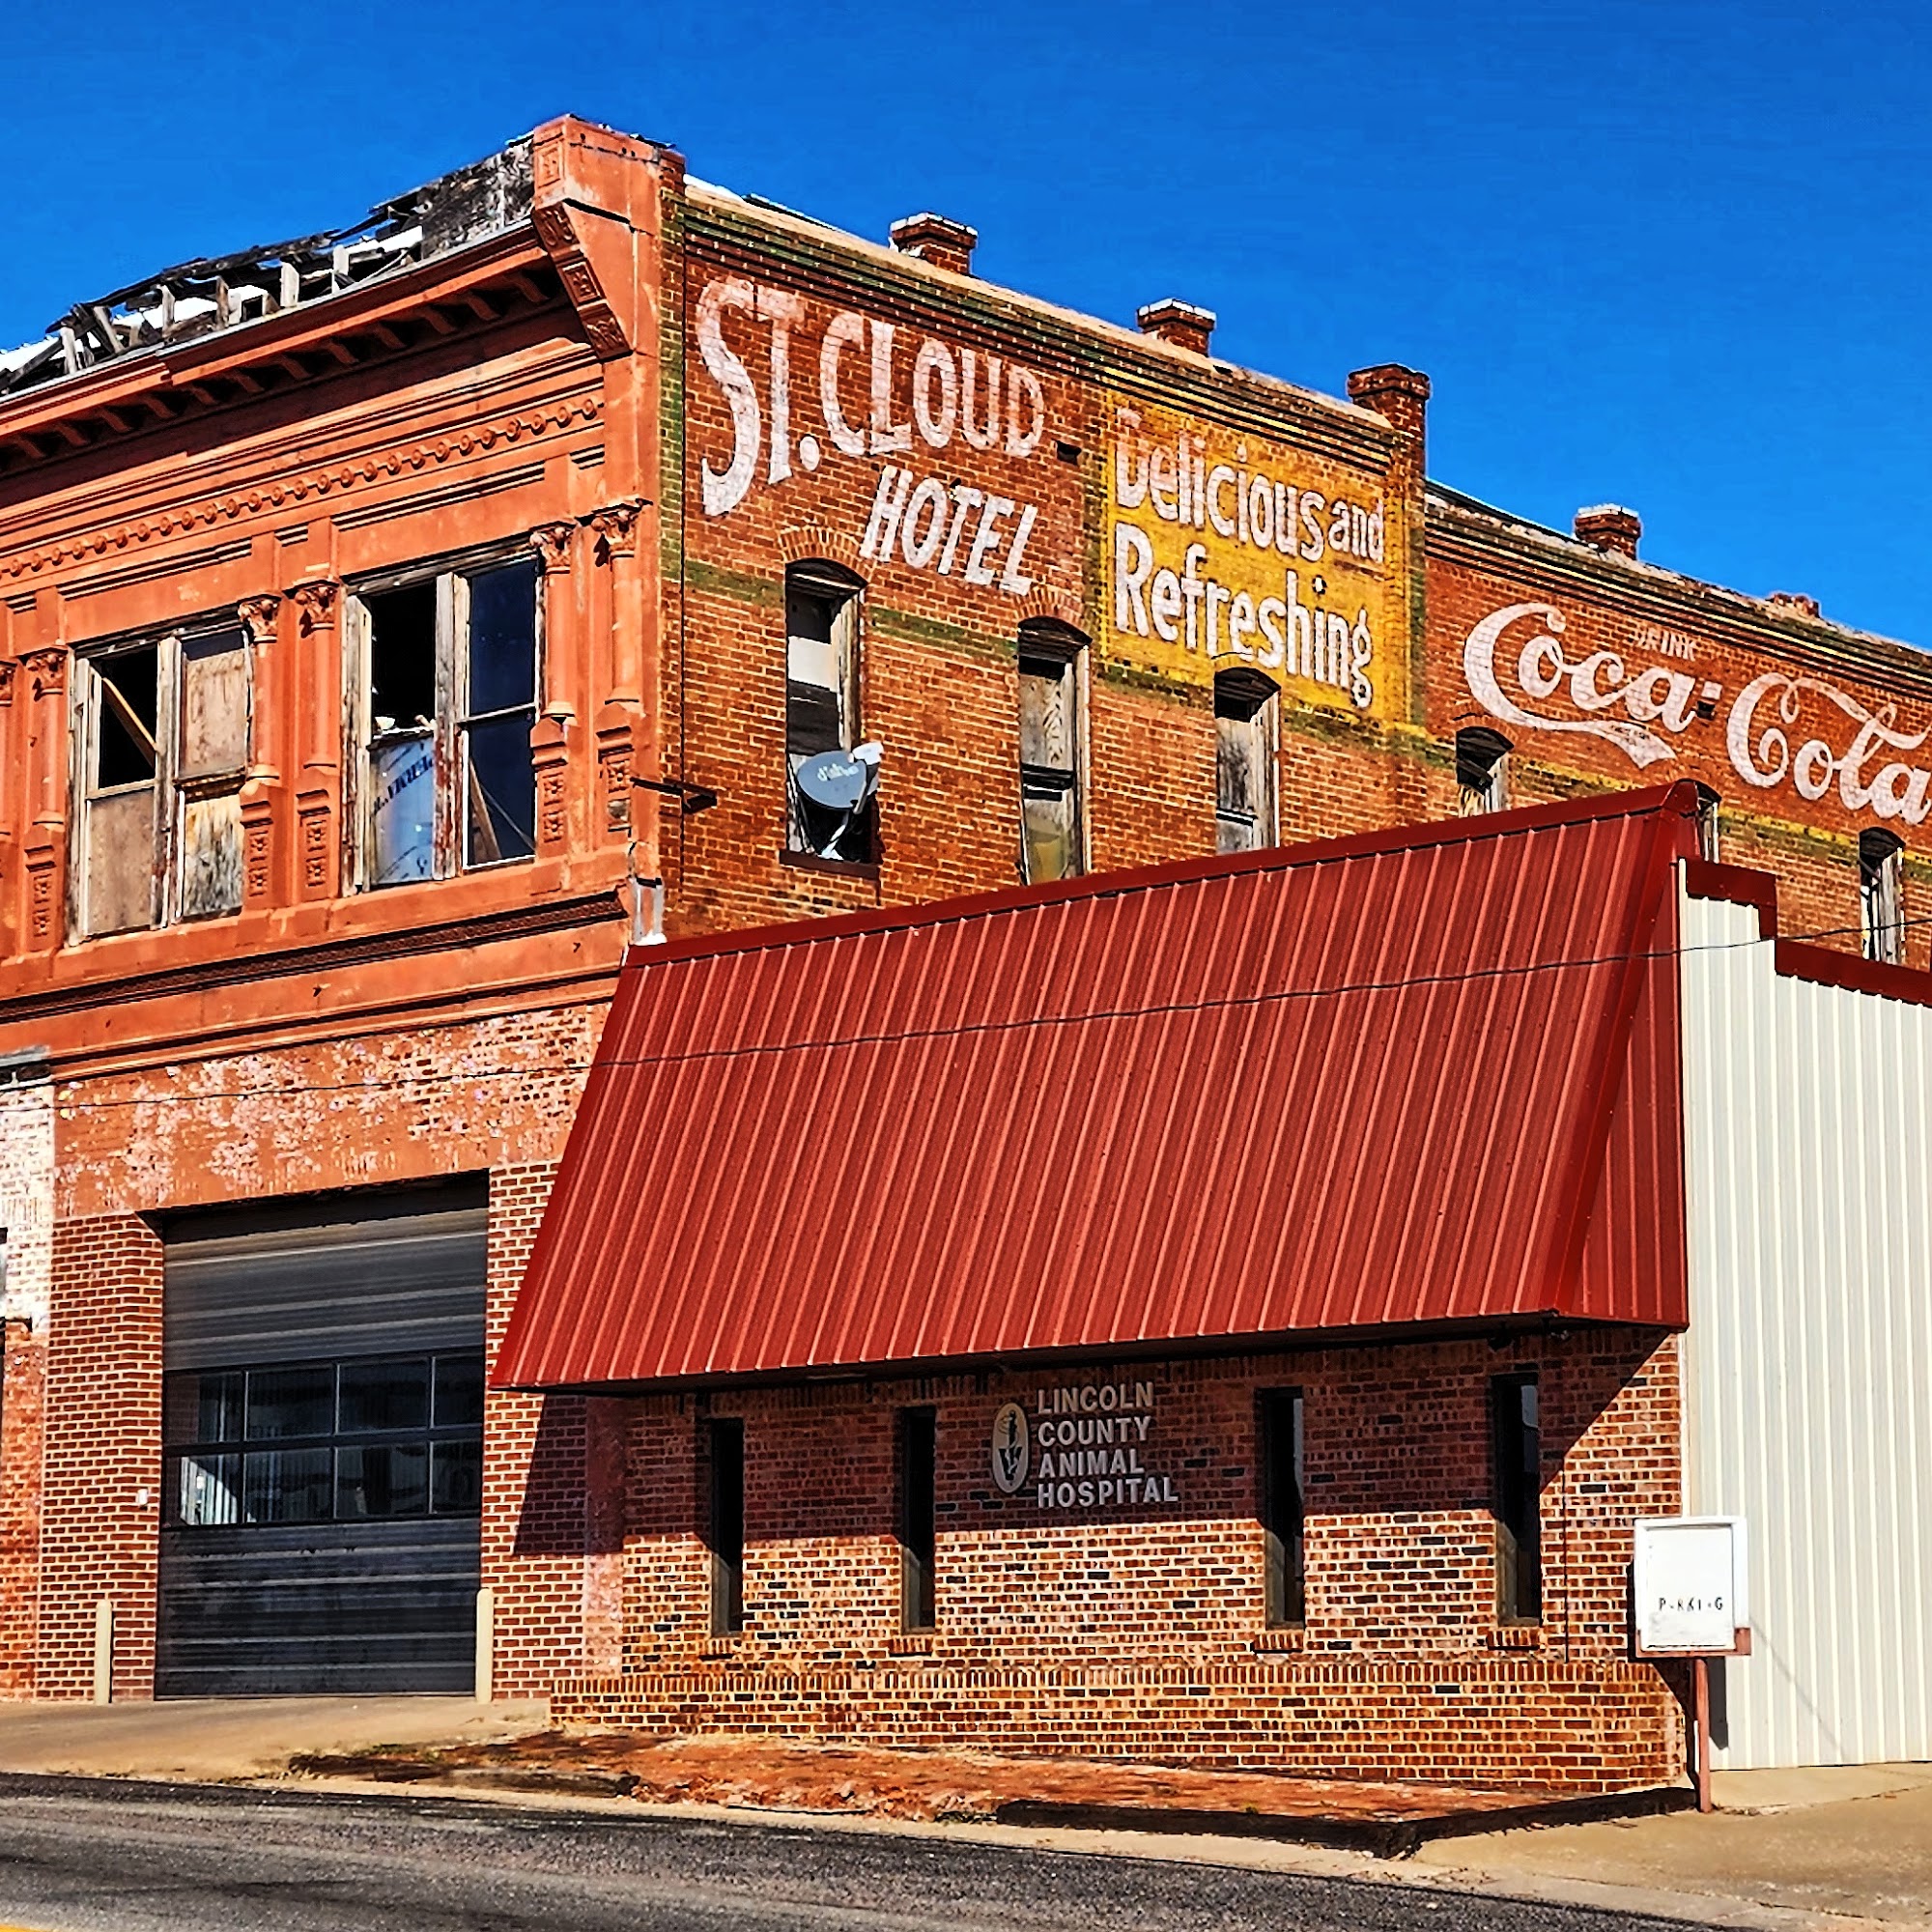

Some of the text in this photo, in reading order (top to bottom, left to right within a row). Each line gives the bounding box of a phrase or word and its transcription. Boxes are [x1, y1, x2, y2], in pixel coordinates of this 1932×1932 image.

[820, 312, 1045, 458] CLOUD
[1116, 407, 1385, 564] Delicious and
[860, 465, 1039, 596] HOTEL
[1115, 522, 1375, 708] Refreshing
[1037, 1381, 1154, 1414] LINCOLN
[1037, 1415, 1152, 1447] COUNTY
[1038, 1448, 1146, 1479] ANIMAL
[1037, 1476, 1179, 1509] HOSPITAL
[1659, 1597, 1723, 1611] PRKIG
